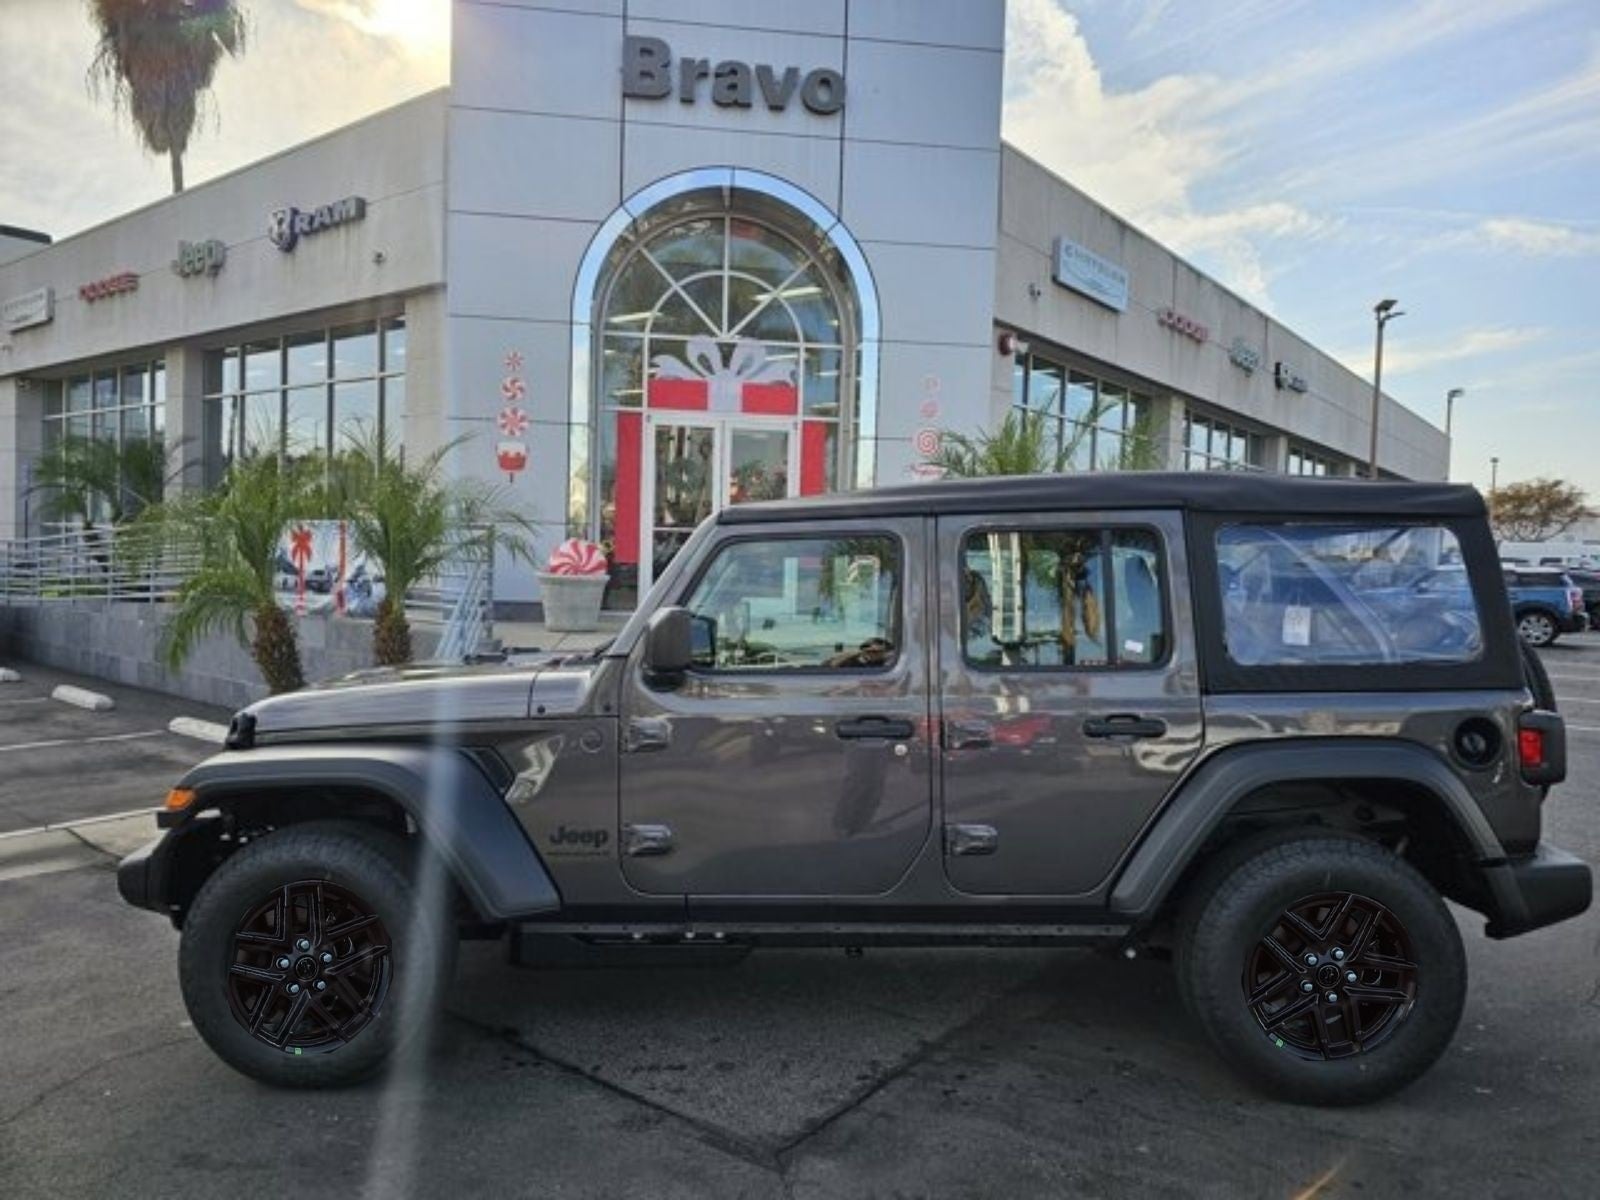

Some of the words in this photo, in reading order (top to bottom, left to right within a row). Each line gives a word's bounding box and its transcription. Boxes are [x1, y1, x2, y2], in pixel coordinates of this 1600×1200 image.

[622, 35, 846, 115] Bravo
[295, 196, 366, 236] RAM
[171, 239, 226, 278] Jeep
[549, 825, 608, 848] Jeep
